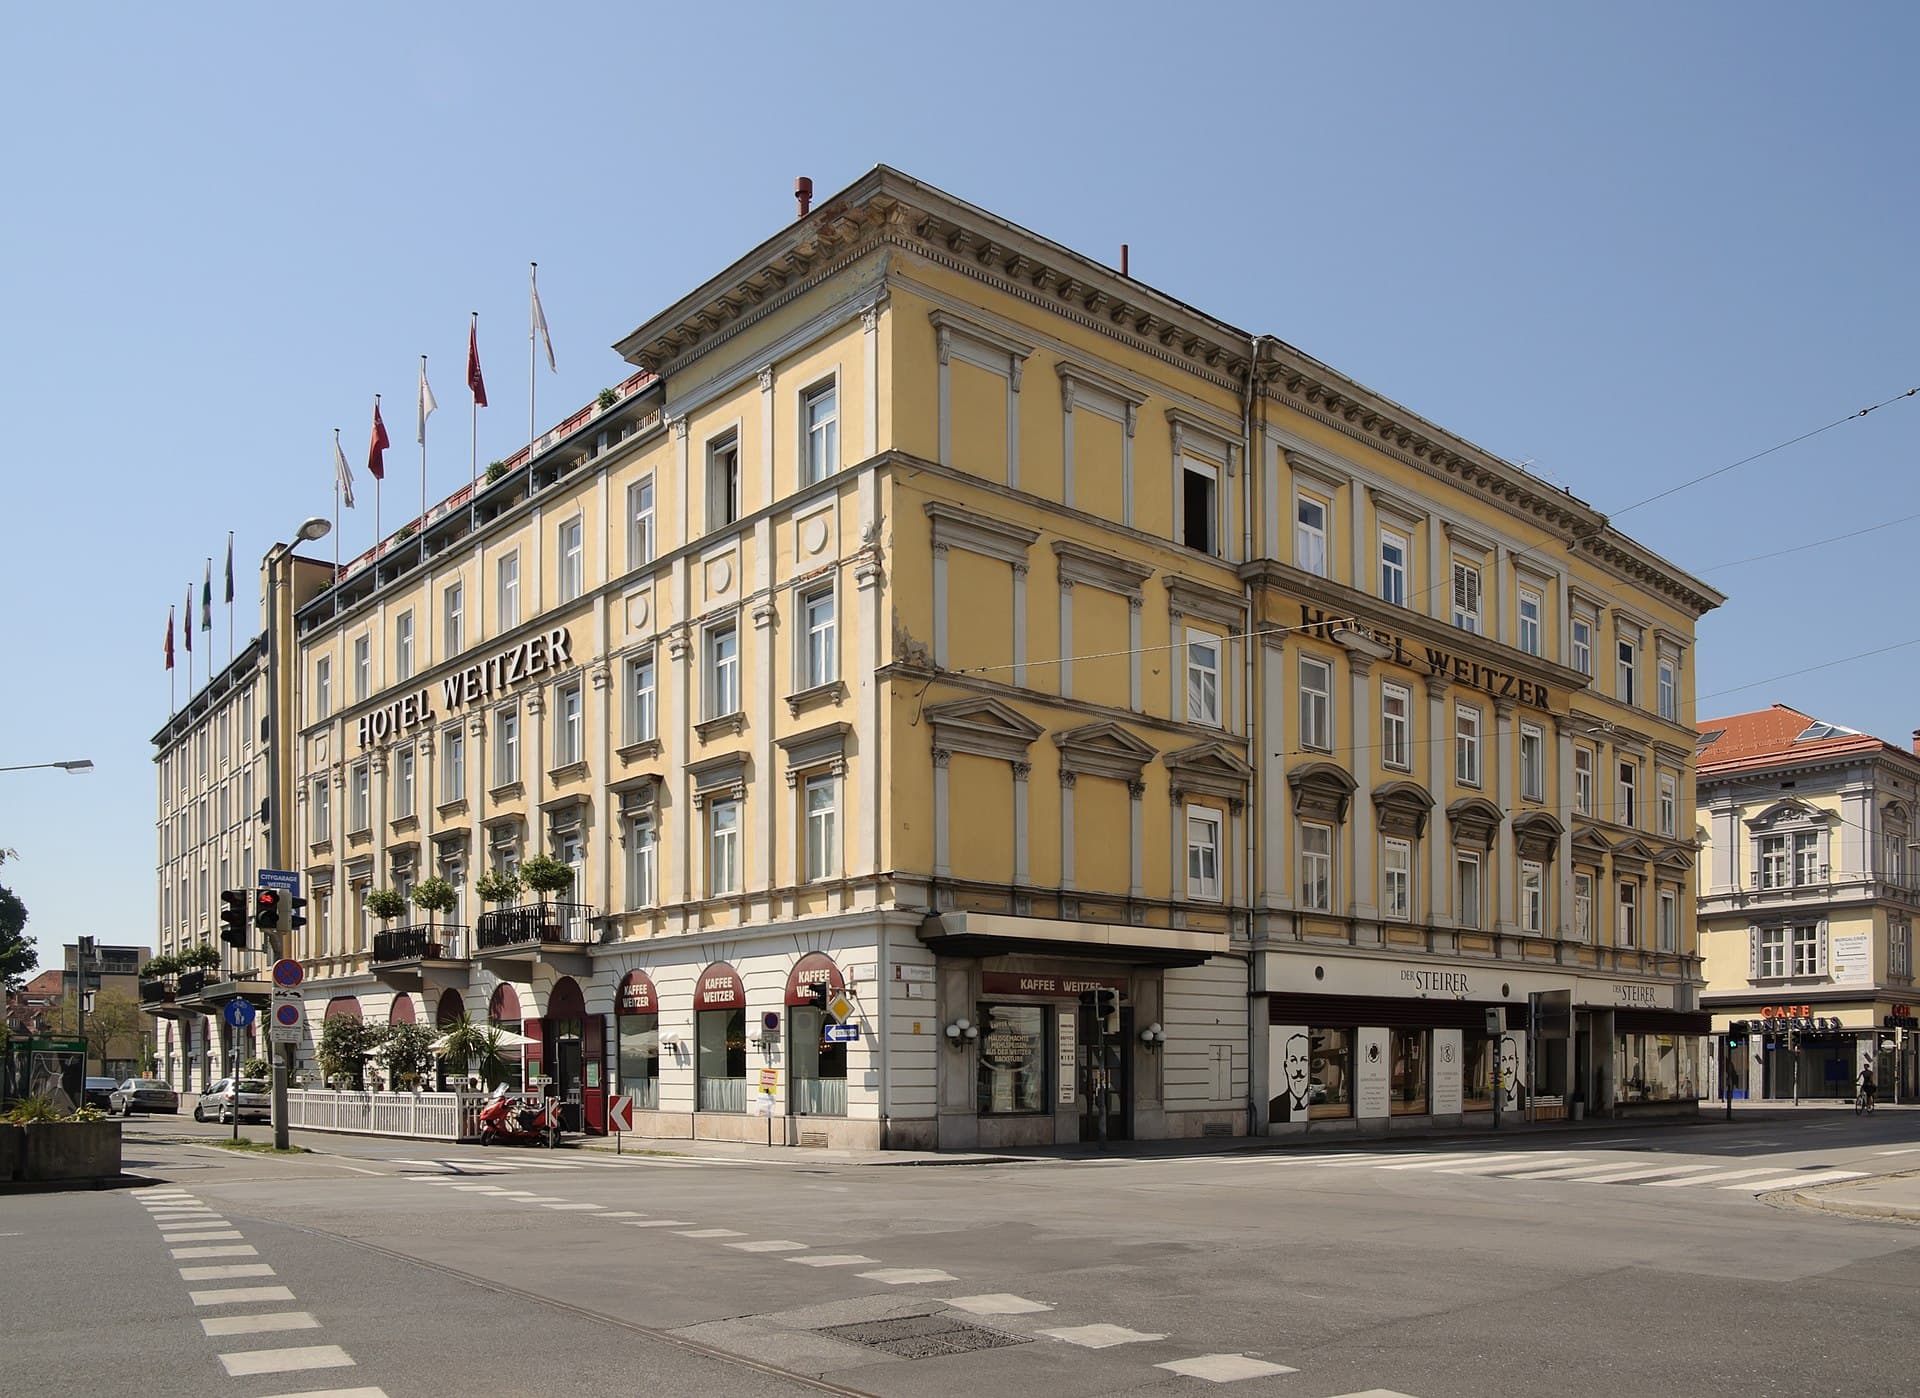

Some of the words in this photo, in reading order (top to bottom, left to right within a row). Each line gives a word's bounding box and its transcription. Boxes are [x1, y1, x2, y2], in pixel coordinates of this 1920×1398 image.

[1300, 605, 1412, 667] HOEL
[1424, 647, 1550, 710] WEITZER
[357, 689, 436, 749] HOTEL
[441, 626, 573, 711] WEITZER
[260, 874, 297, 882] CITYGARAGE
[704, 976, 733, 990] KAFFEE
[798, 969, 831, 983] KAFFEE
[1400, 970, 1415, 981] DER
[1416, 971, 1470, 995] STEIRER
[624, 984, 648, 996] KAFFEE
[1020, 978, 1055, 991] KAFFEE
[703, 990, 735, 1003] WEITZER
[1622, 985, 1656, 1003] STEIRER
[622, 996, 649, 1008] WEITZER
[1760, 1005, 1811, 1019] CAFE
[1740, 1016, 1841, 1031] ENERALS
